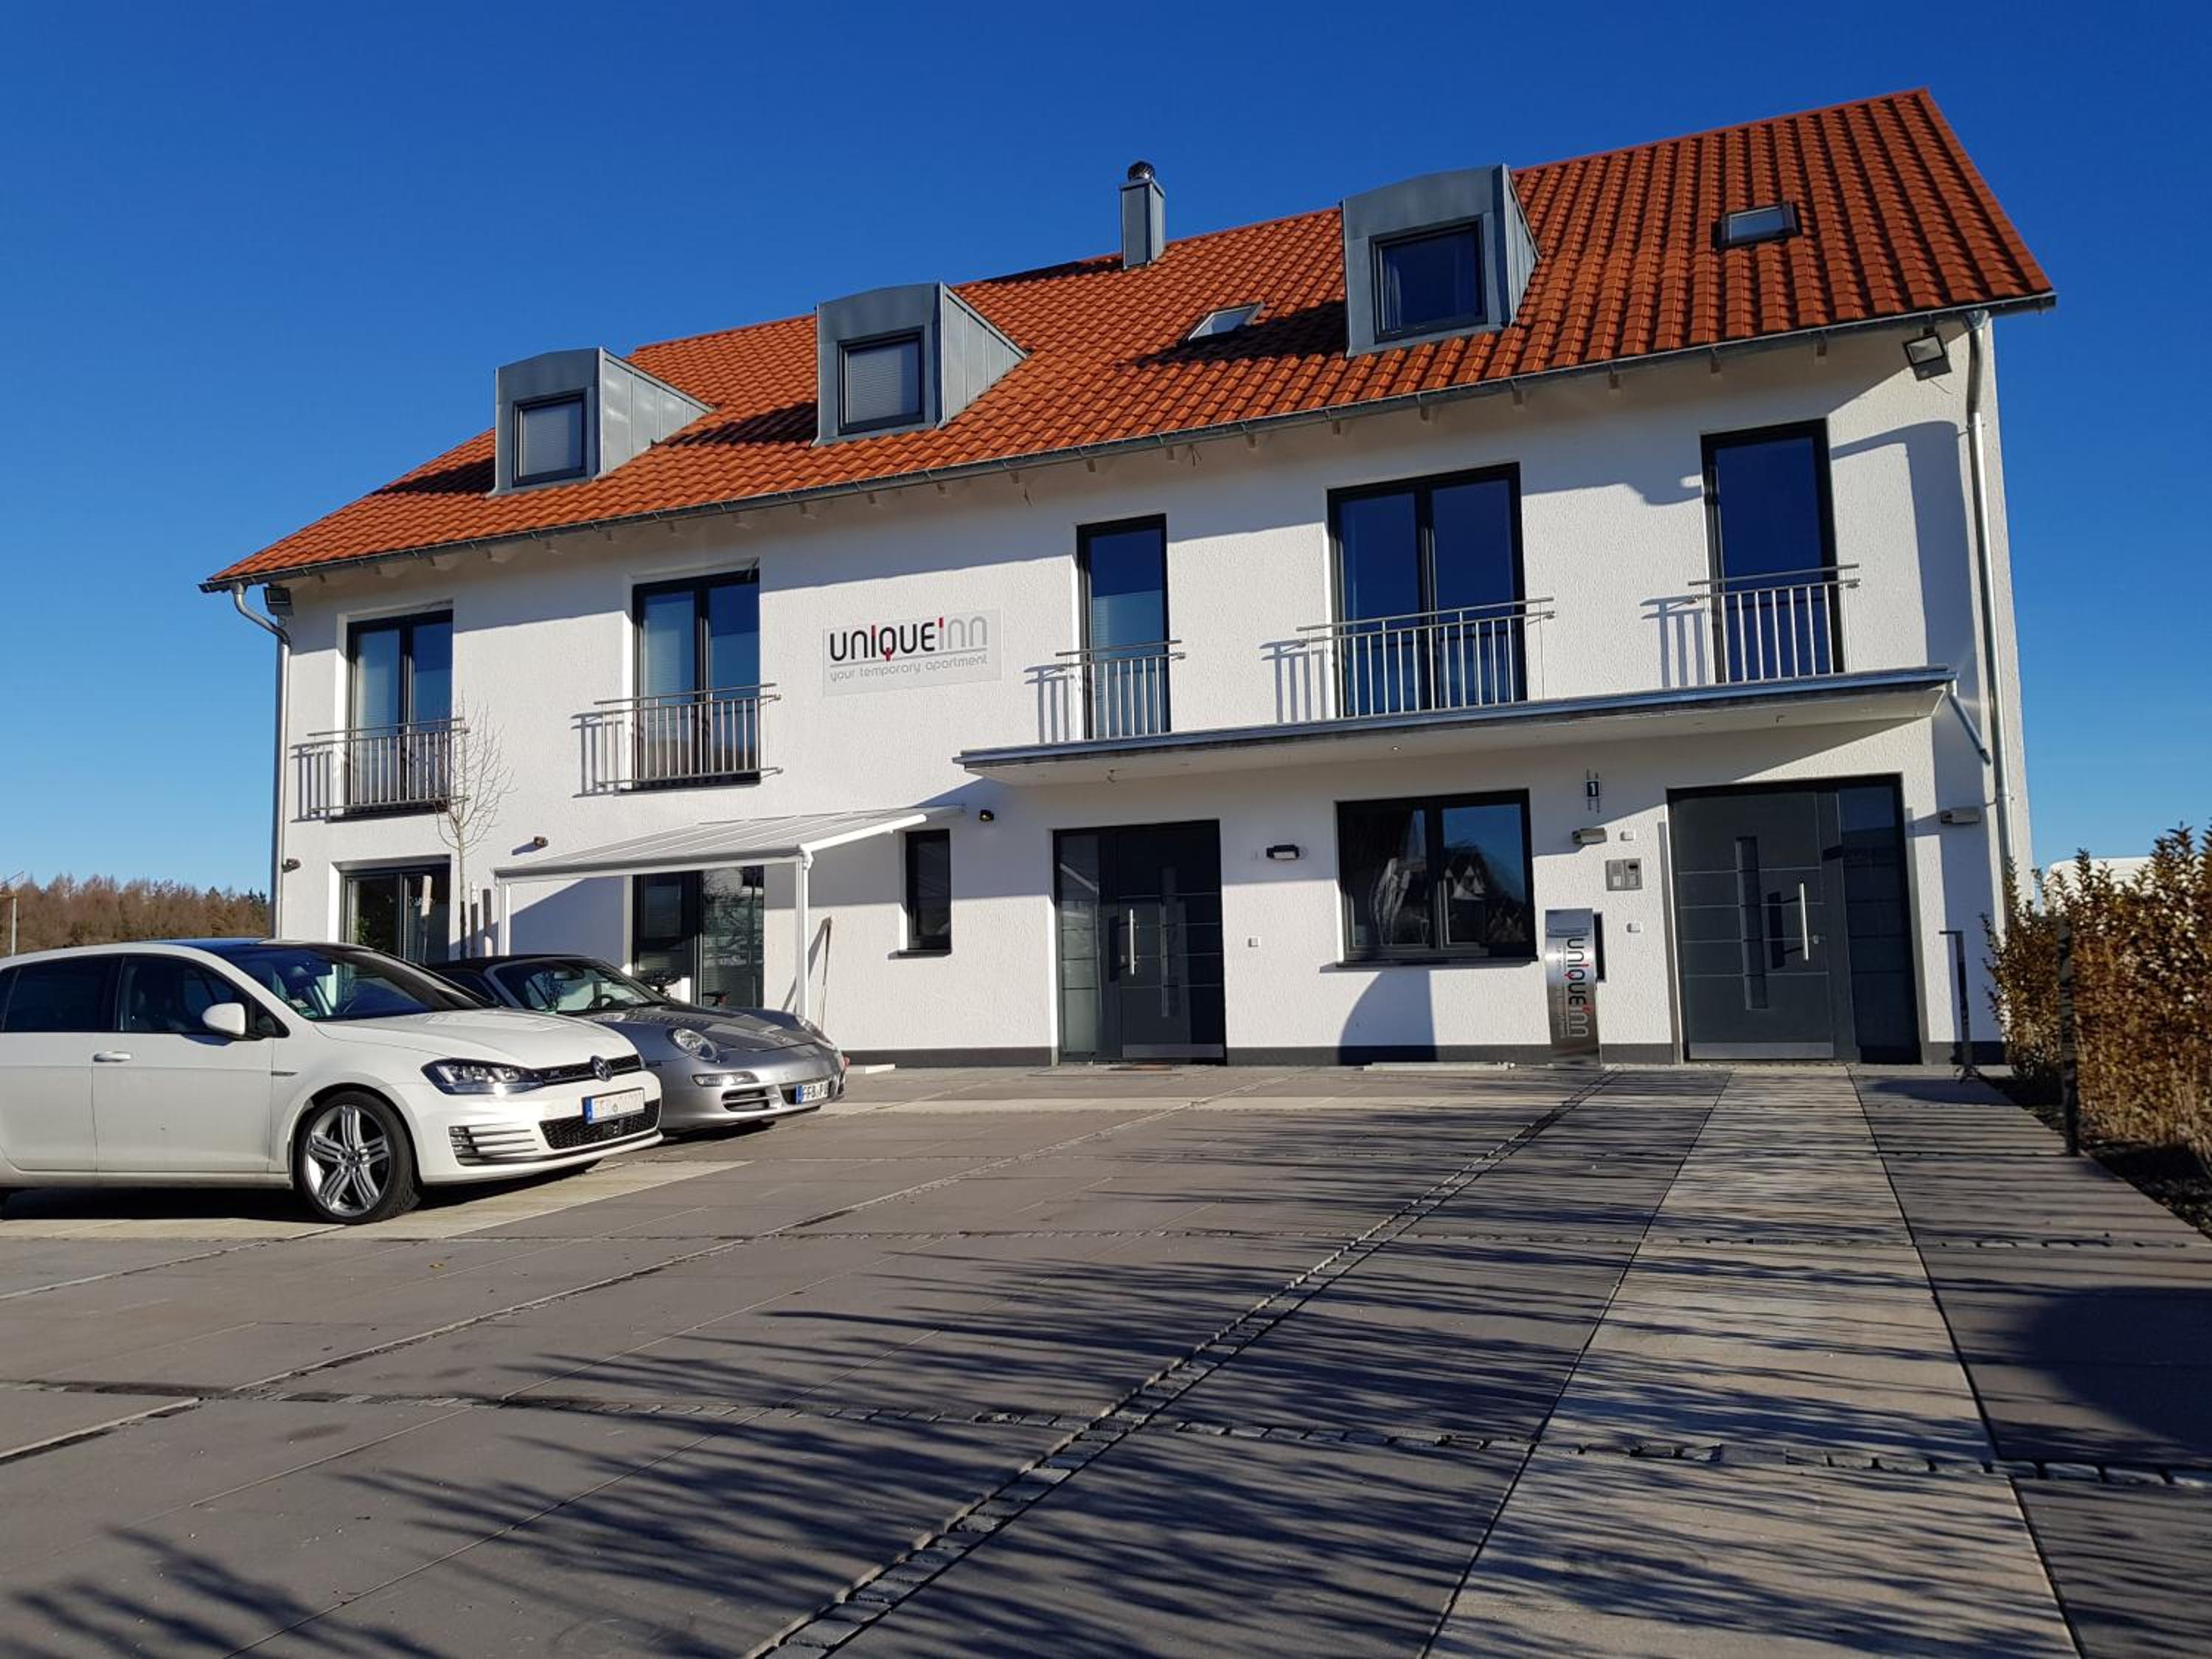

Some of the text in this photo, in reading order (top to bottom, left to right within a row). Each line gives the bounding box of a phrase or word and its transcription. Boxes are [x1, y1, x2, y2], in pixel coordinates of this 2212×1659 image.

[830, 654, 987, 682] your temporary apartment
[1590, 782, 1596, 796] 1
